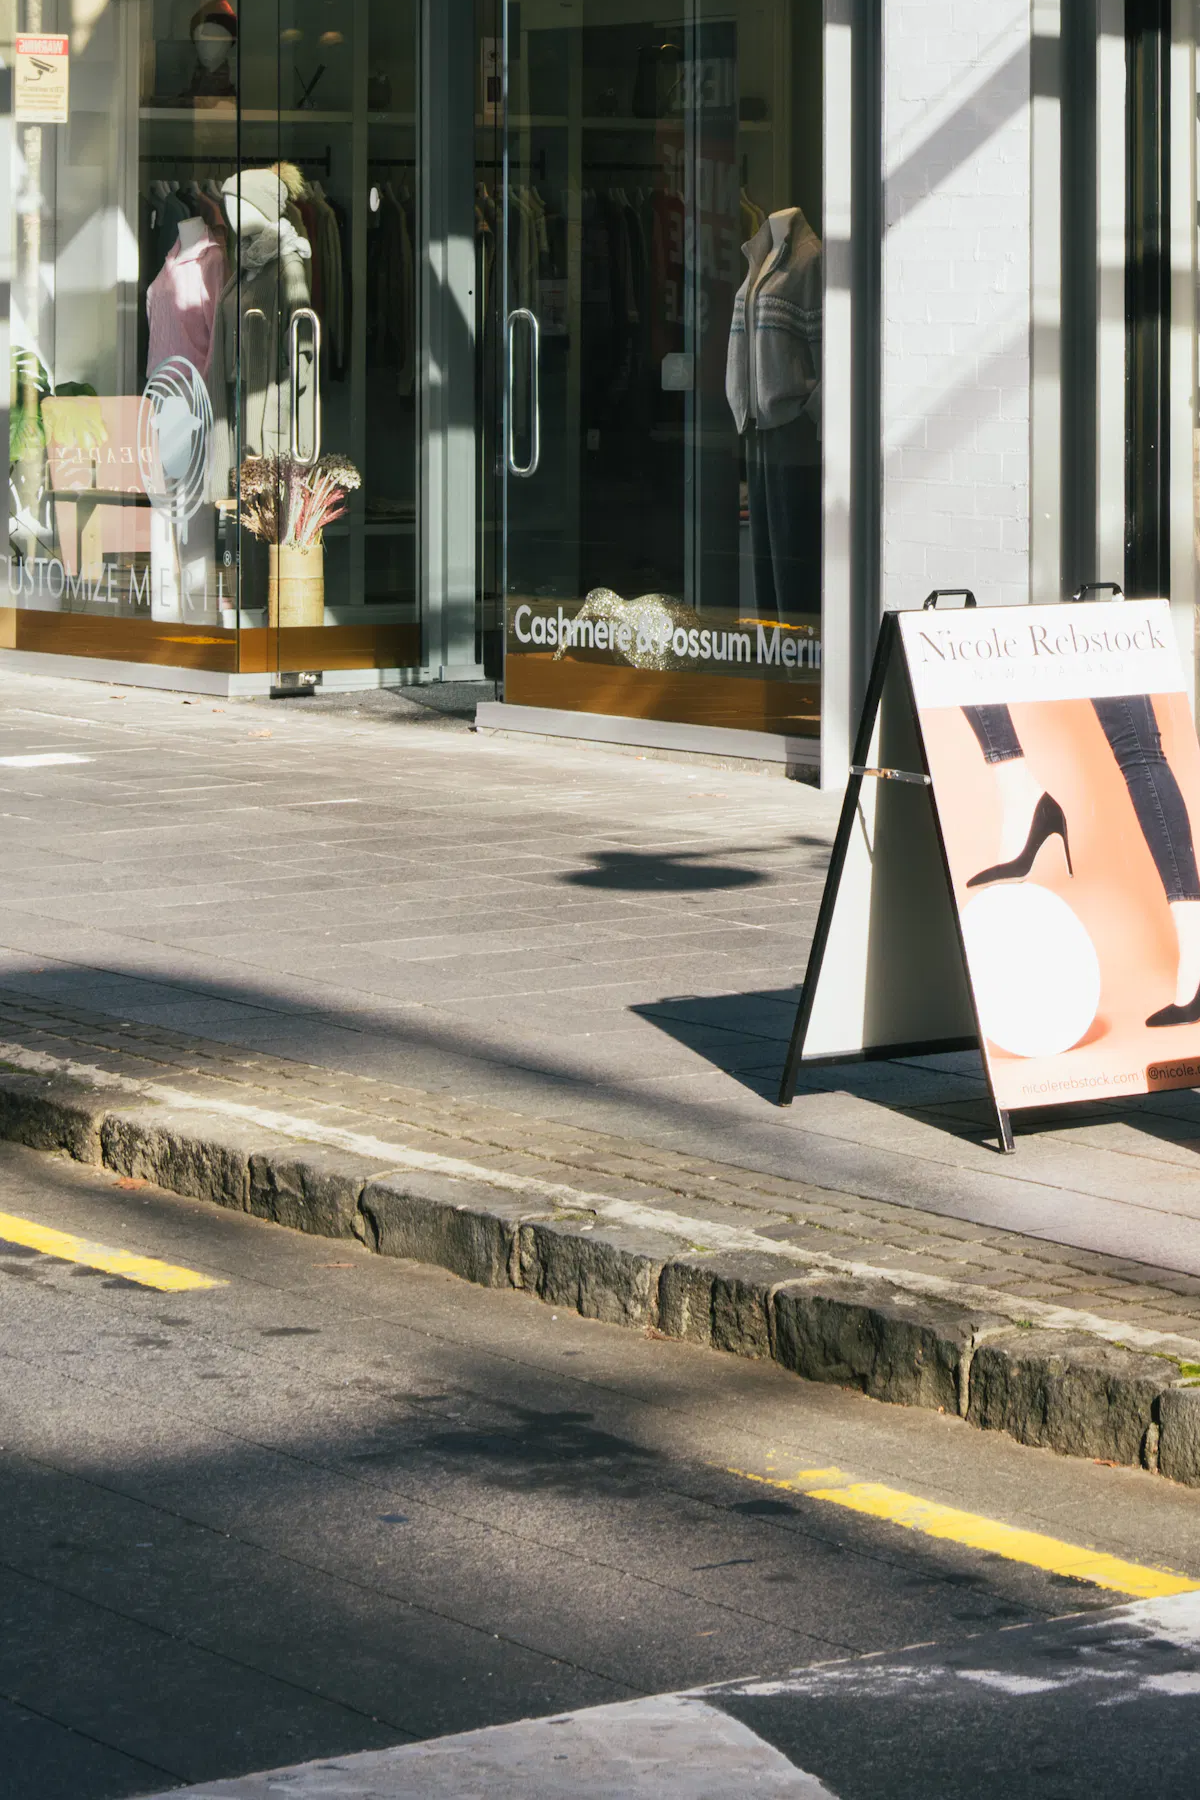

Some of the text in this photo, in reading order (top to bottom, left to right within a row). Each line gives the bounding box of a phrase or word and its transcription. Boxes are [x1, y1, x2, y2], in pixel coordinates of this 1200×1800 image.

[514, 604, 633, 651] Cashmere
[659, 616, 751, 663] Possum
[918, 619, 1166, 663] Nicole Rebstock
[1022, 1073, 1141, 1096] nicolerebstock.com
